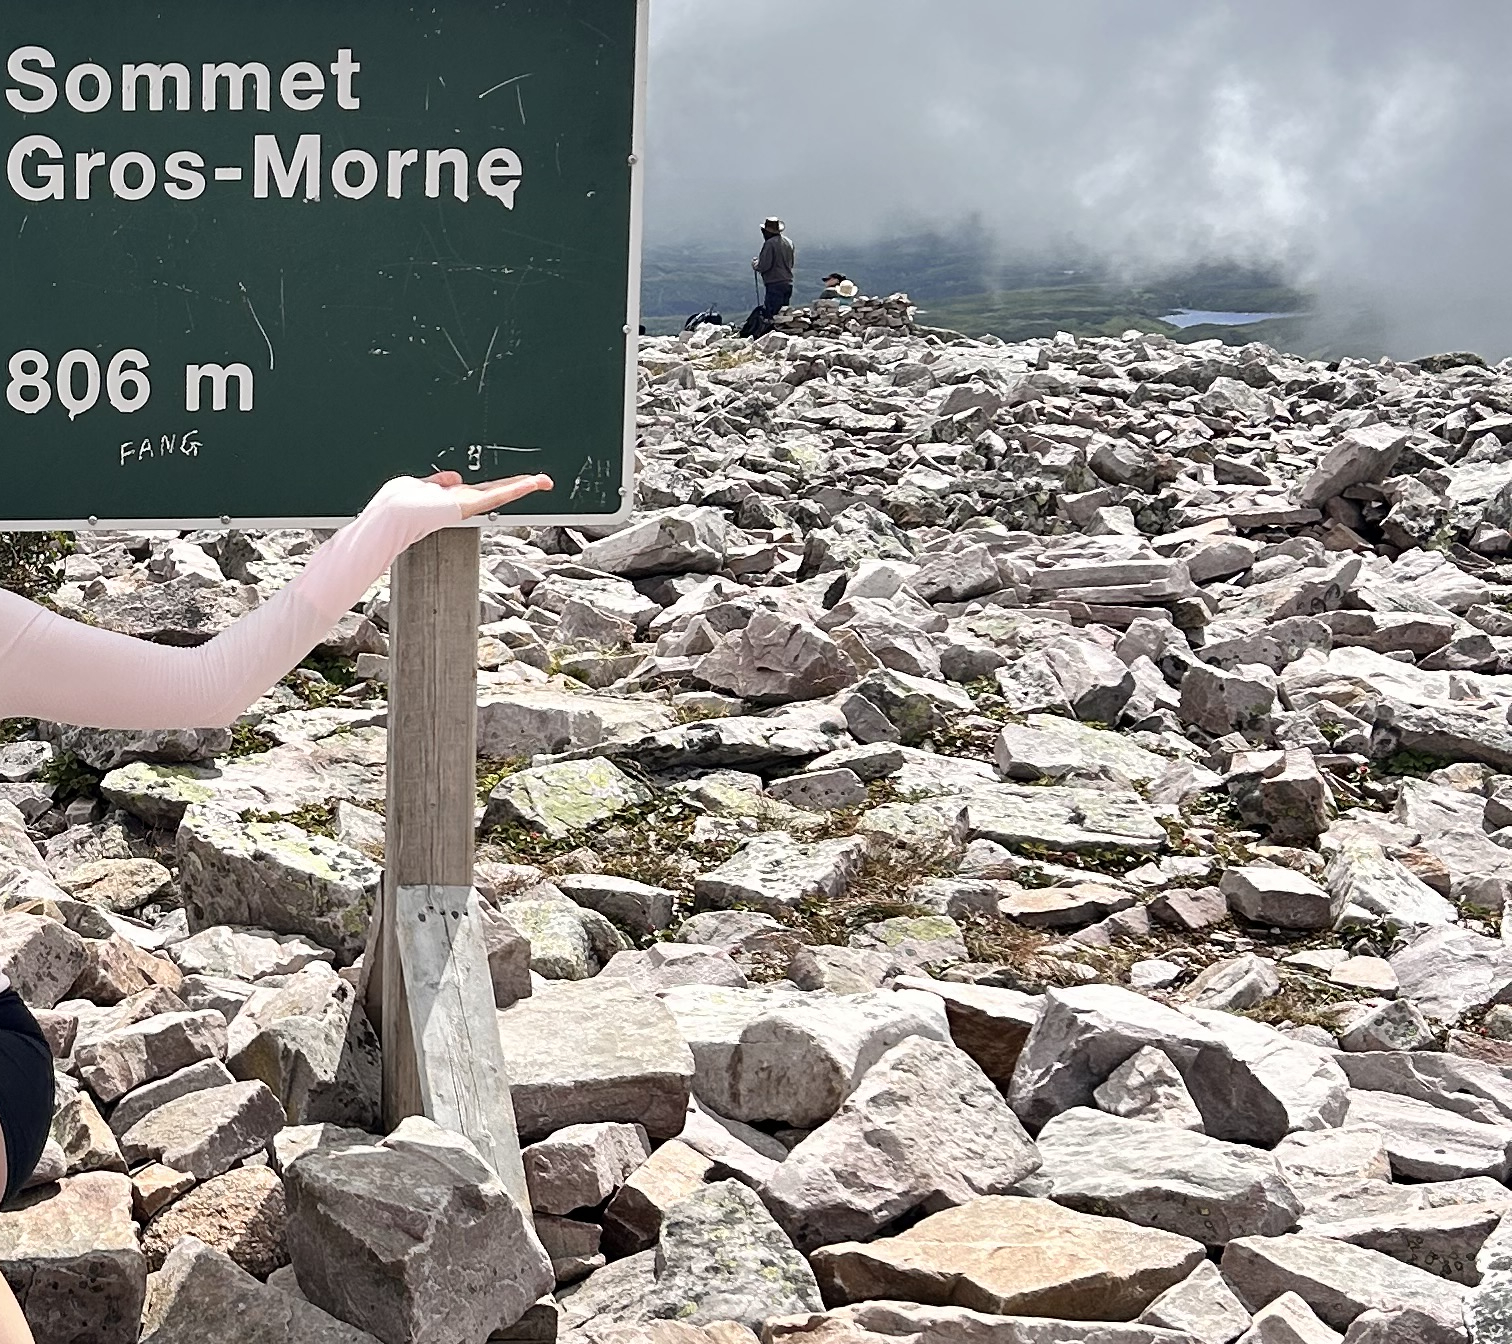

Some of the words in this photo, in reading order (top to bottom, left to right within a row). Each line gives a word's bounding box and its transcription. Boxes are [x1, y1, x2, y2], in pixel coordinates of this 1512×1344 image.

[5, 45, 362, 113] Sommet
[6, 134, 524, 208] Gros-Morne
[6, 349, 151, 420] 806
[185, 362, 254, 412] m
[119, 429, 204, 467] FANG
